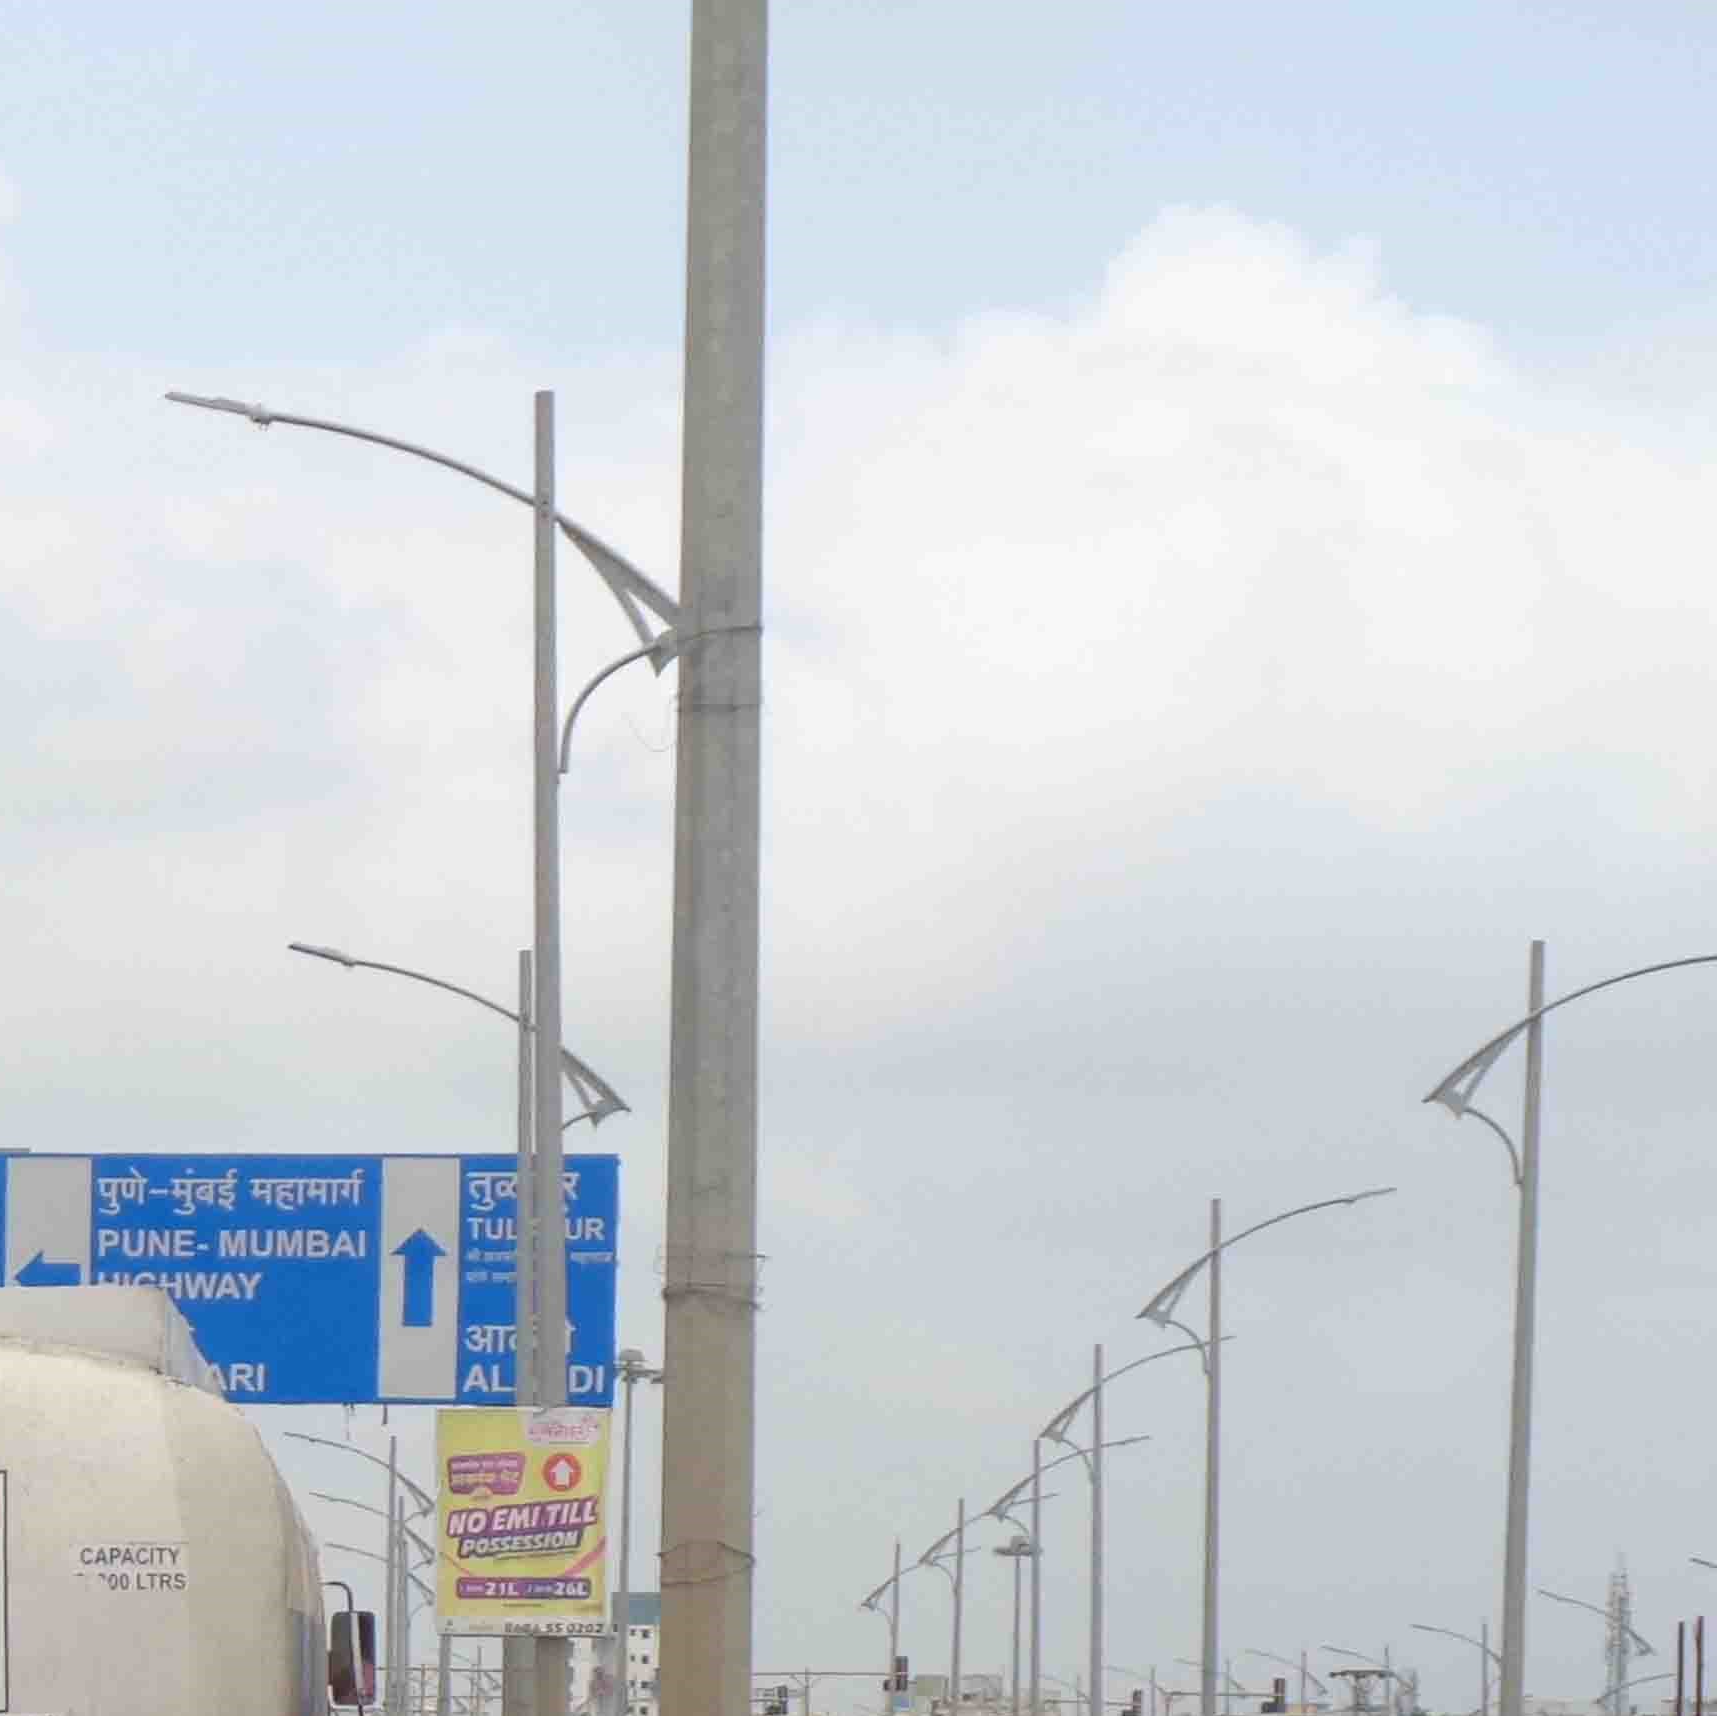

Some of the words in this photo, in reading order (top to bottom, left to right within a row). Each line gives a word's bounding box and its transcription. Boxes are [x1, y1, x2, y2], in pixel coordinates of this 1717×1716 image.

[249, 1168, 364, 1211] महामार्ग
[466, 1217, 606, 1241] TULUR
[219, 1230, 366, 1258] MUMBAI
[463, 1363, 606, 1394] ALDI
[448, 1511, 488, 1536] NO
[492, 1506, 542, 1532] EMI
[545, 1498, 598, 1526] TILL
[79, 1546, 181, 1566] CAPACITY
[460, 1530, 581, 1558] POSSESSION
[136, 1572, 187, 1591] LTRS
